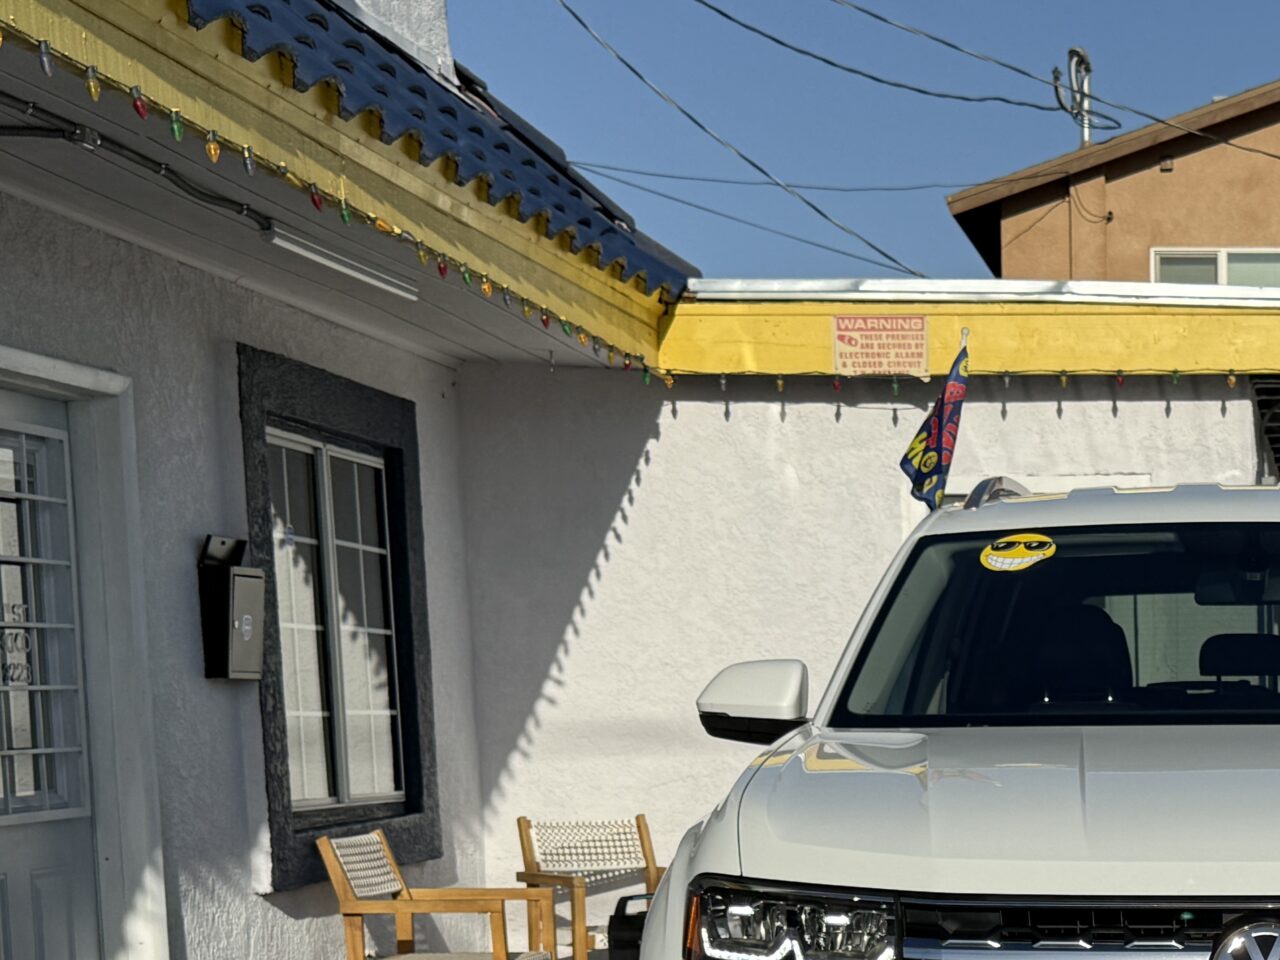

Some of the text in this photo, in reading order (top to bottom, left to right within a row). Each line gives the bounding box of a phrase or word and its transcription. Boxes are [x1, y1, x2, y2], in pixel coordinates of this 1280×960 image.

[838, 318, 923, 330] WARNING
[860, 333, 924, 341] THESE PREMISES
[860, 342, 924, 350] ARE SECURED BY
[839, 351, 924, 360] ELECTRONIC ALARM
[851, 361, 883, 369] CLOSED
[887, 361, 922, 369] CIRCUIT
